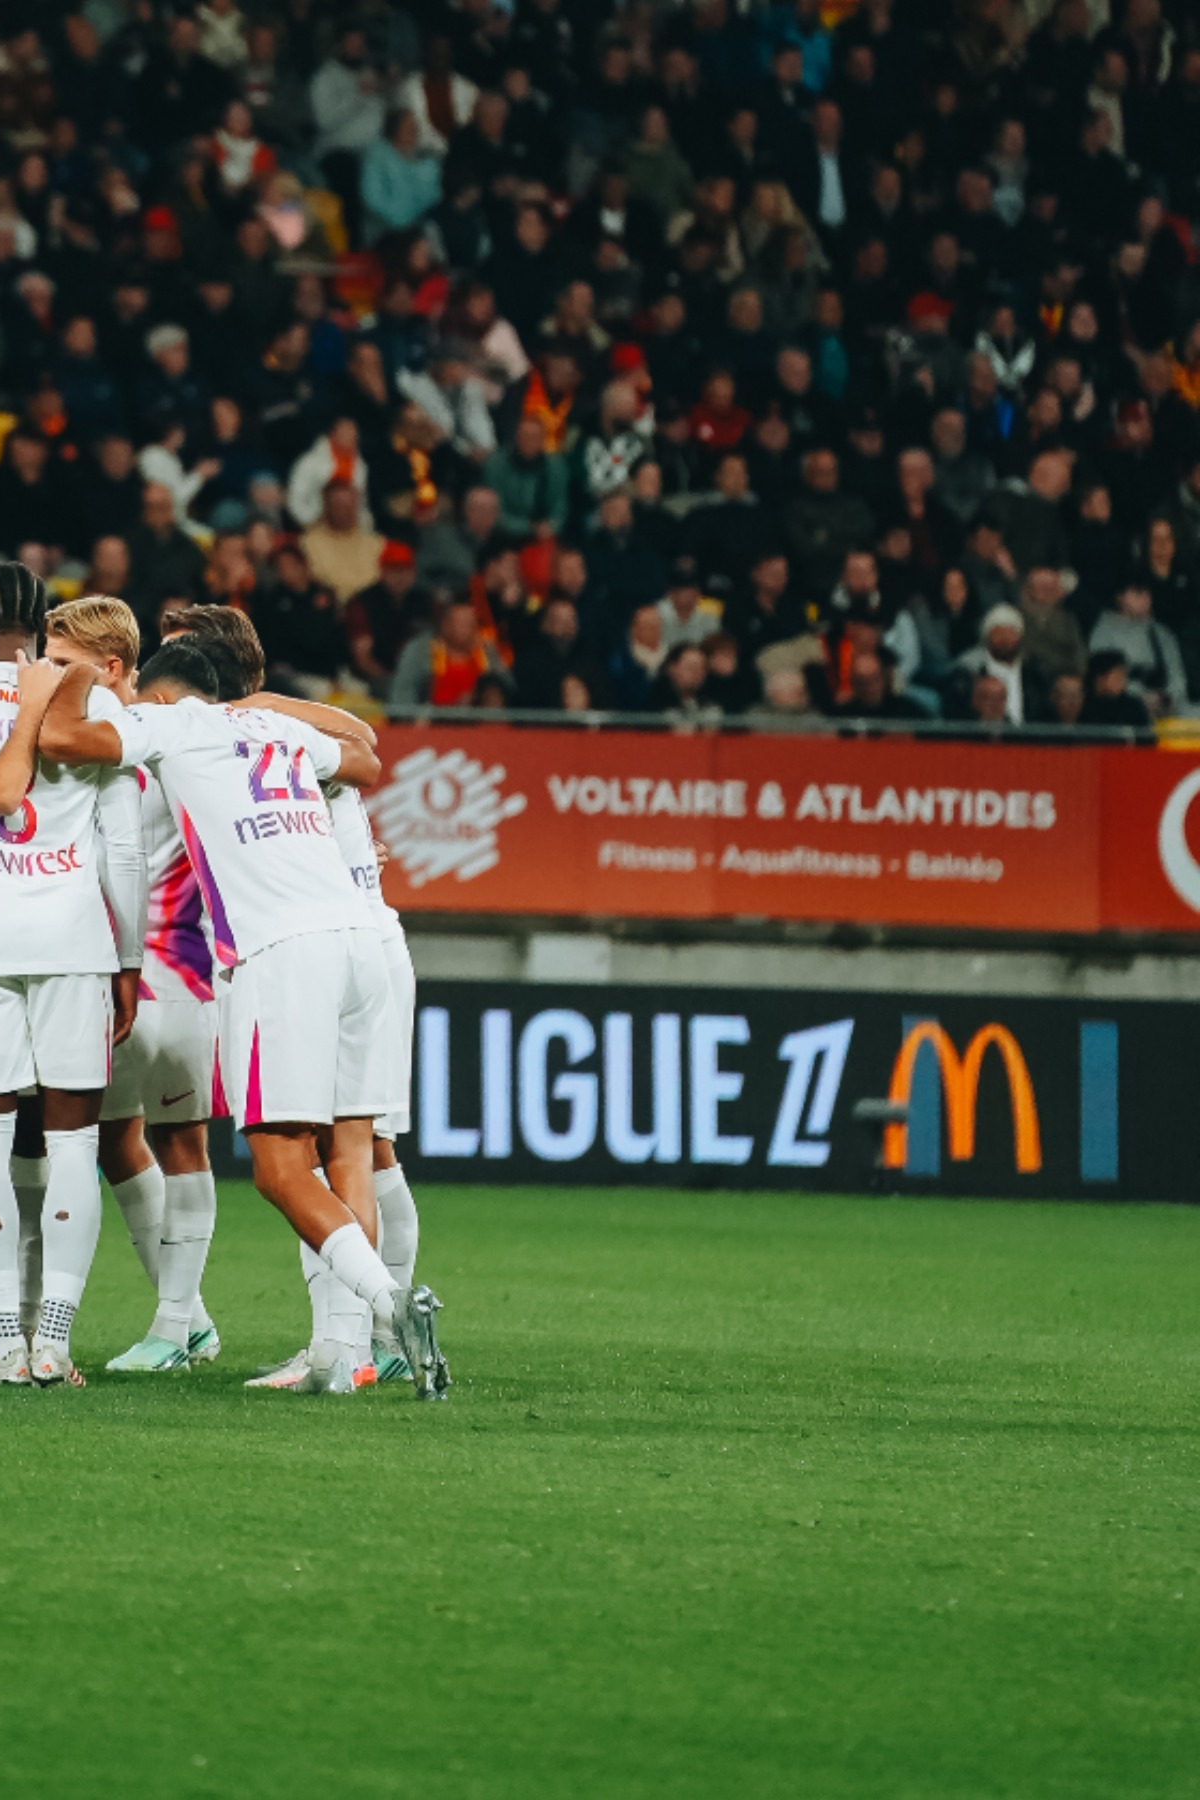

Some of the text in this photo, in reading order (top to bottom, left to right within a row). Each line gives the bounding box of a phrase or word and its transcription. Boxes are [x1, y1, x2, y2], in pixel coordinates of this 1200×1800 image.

[546, 775, 1057, 829] VOLTAIRE & ATLANTIDES
[599, 840, 697, 872] Fitness
[419, 1006, 754, 1165] LIGUE
